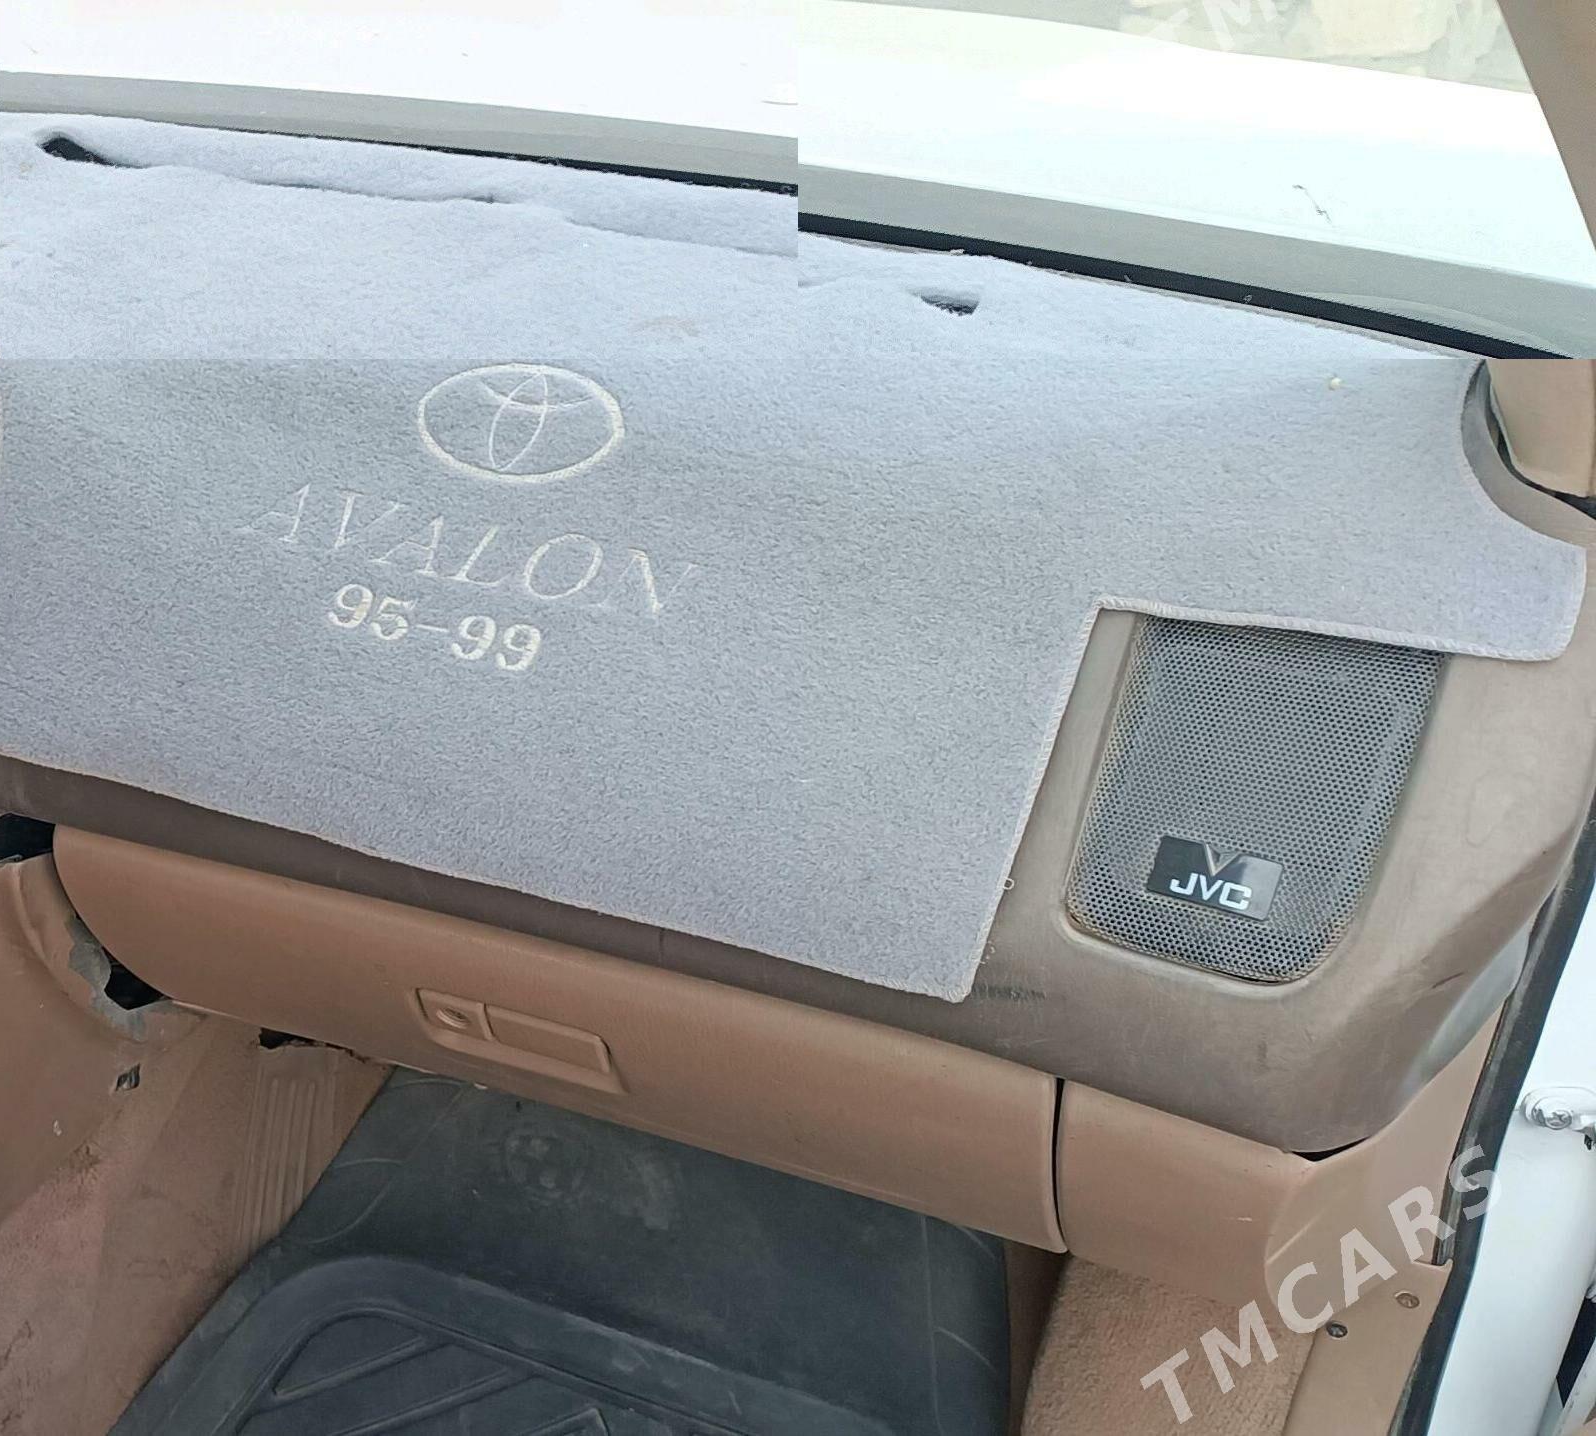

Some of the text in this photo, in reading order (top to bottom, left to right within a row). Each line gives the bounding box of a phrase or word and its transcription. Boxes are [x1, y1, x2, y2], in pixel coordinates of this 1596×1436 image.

[233, 483, 702, 617] AVALON
[327, 583, 543, 671] 95-99
[1169, 872, 1252, 911] JVC
